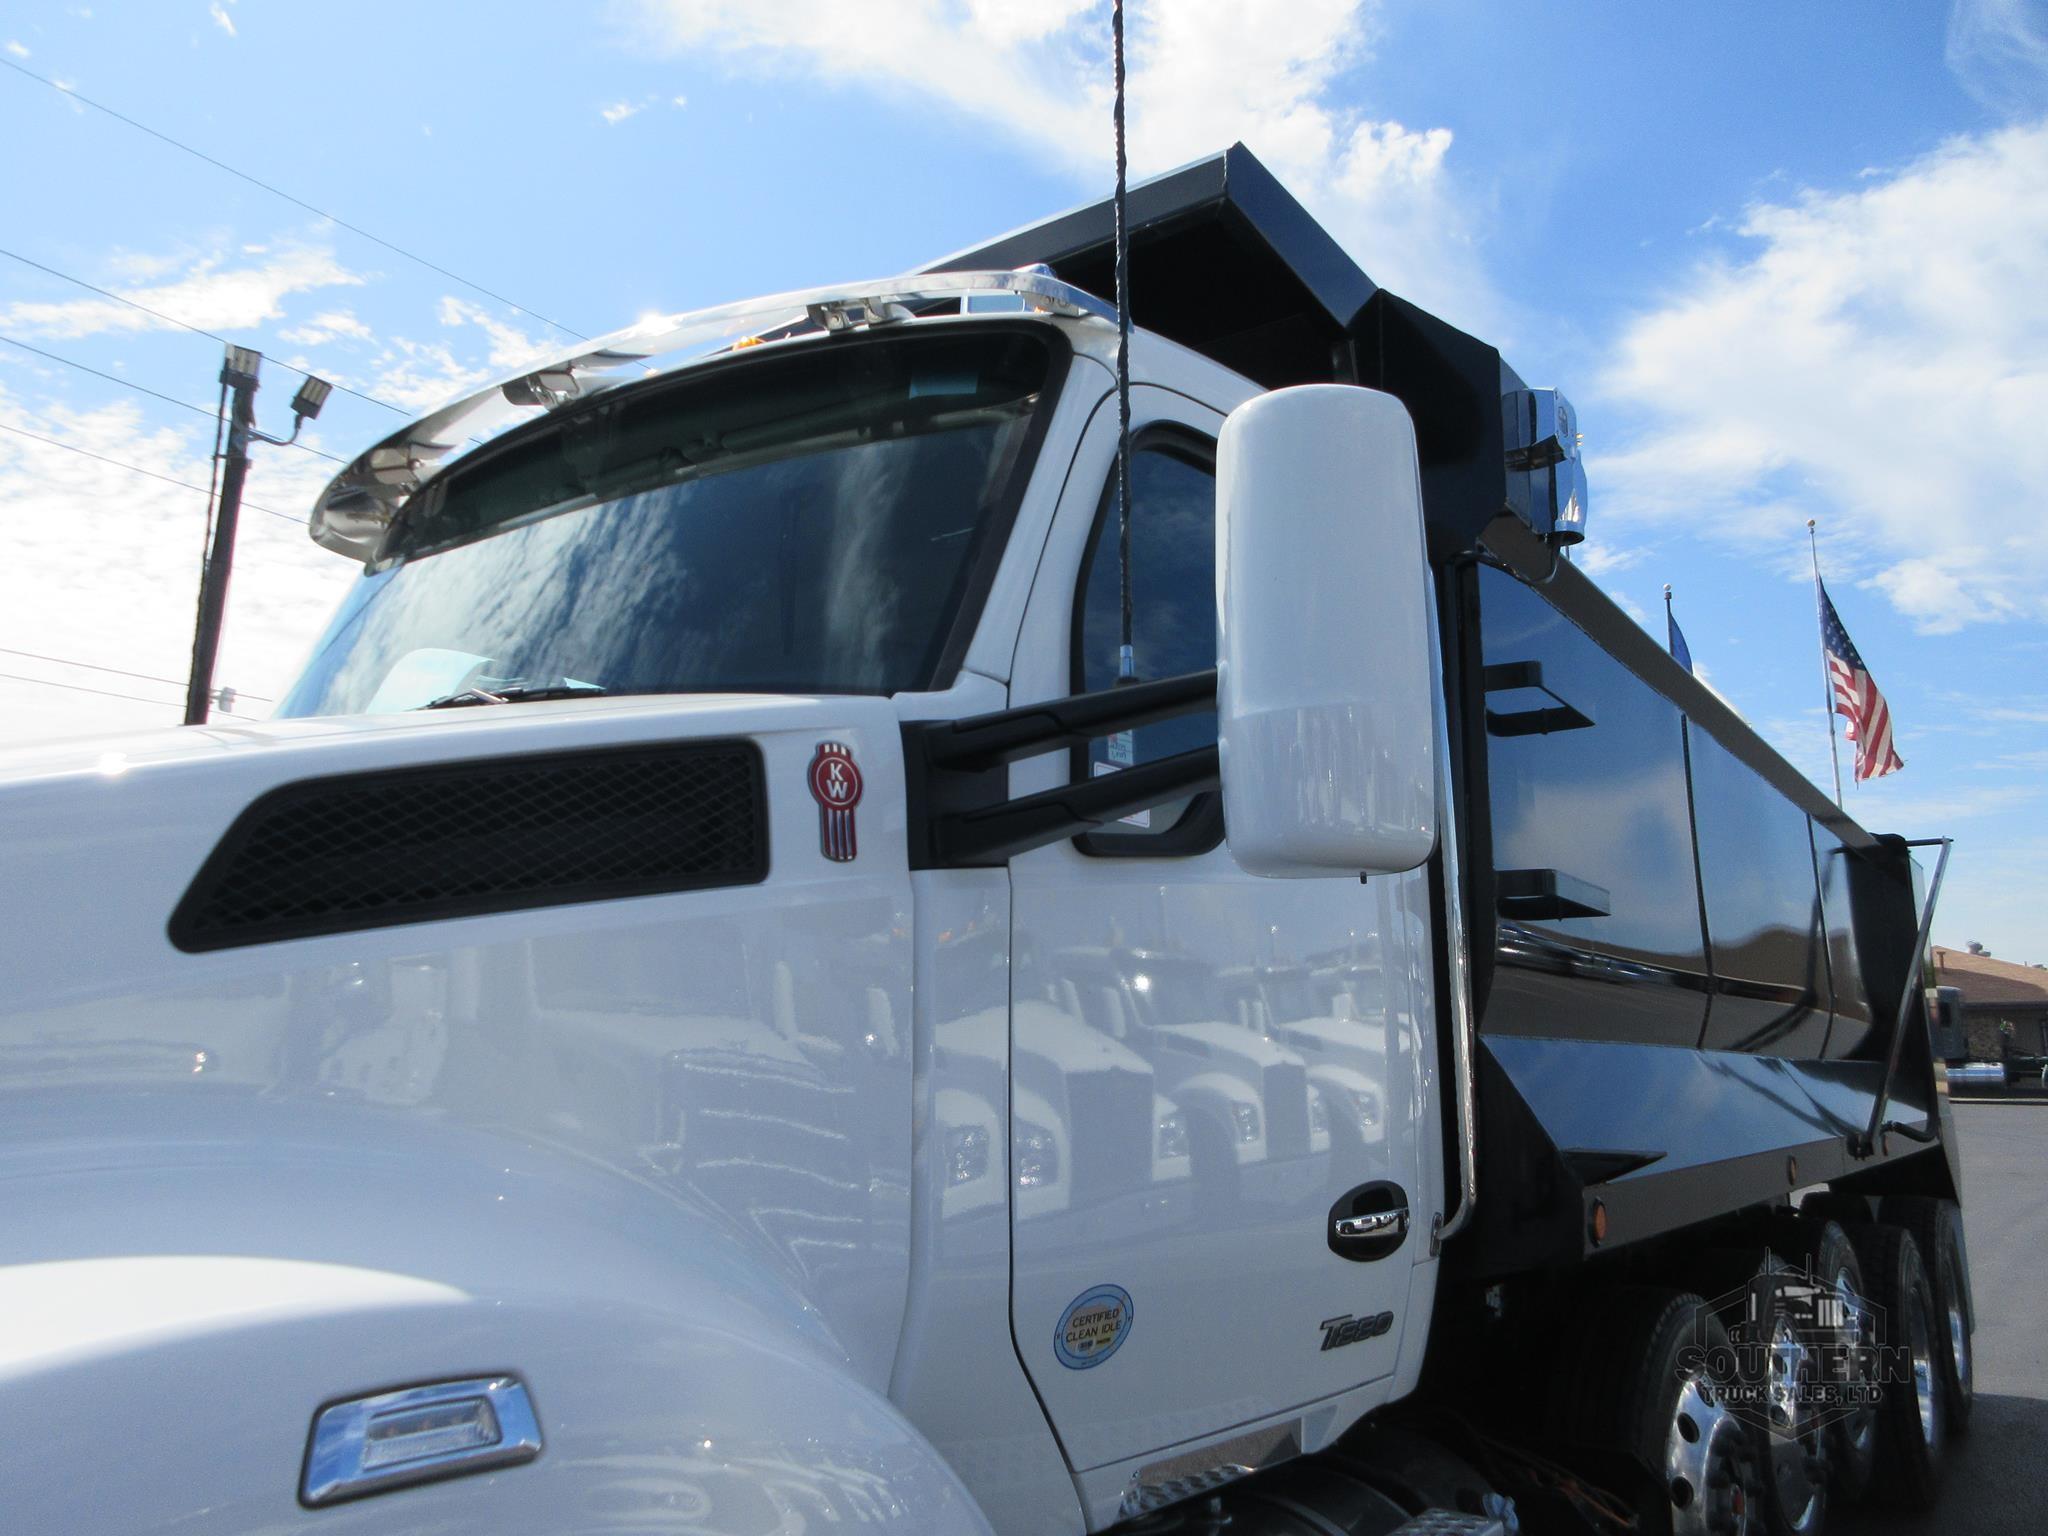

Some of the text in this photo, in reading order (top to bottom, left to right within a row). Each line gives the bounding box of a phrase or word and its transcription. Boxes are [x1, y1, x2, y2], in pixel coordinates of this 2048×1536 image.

[1072, 1308, 1120, 1328] CERTIFIED
[1065, 1326, 1098, 1342] CLEAN
[1101, 1320, 1122, 1334] IDLE
